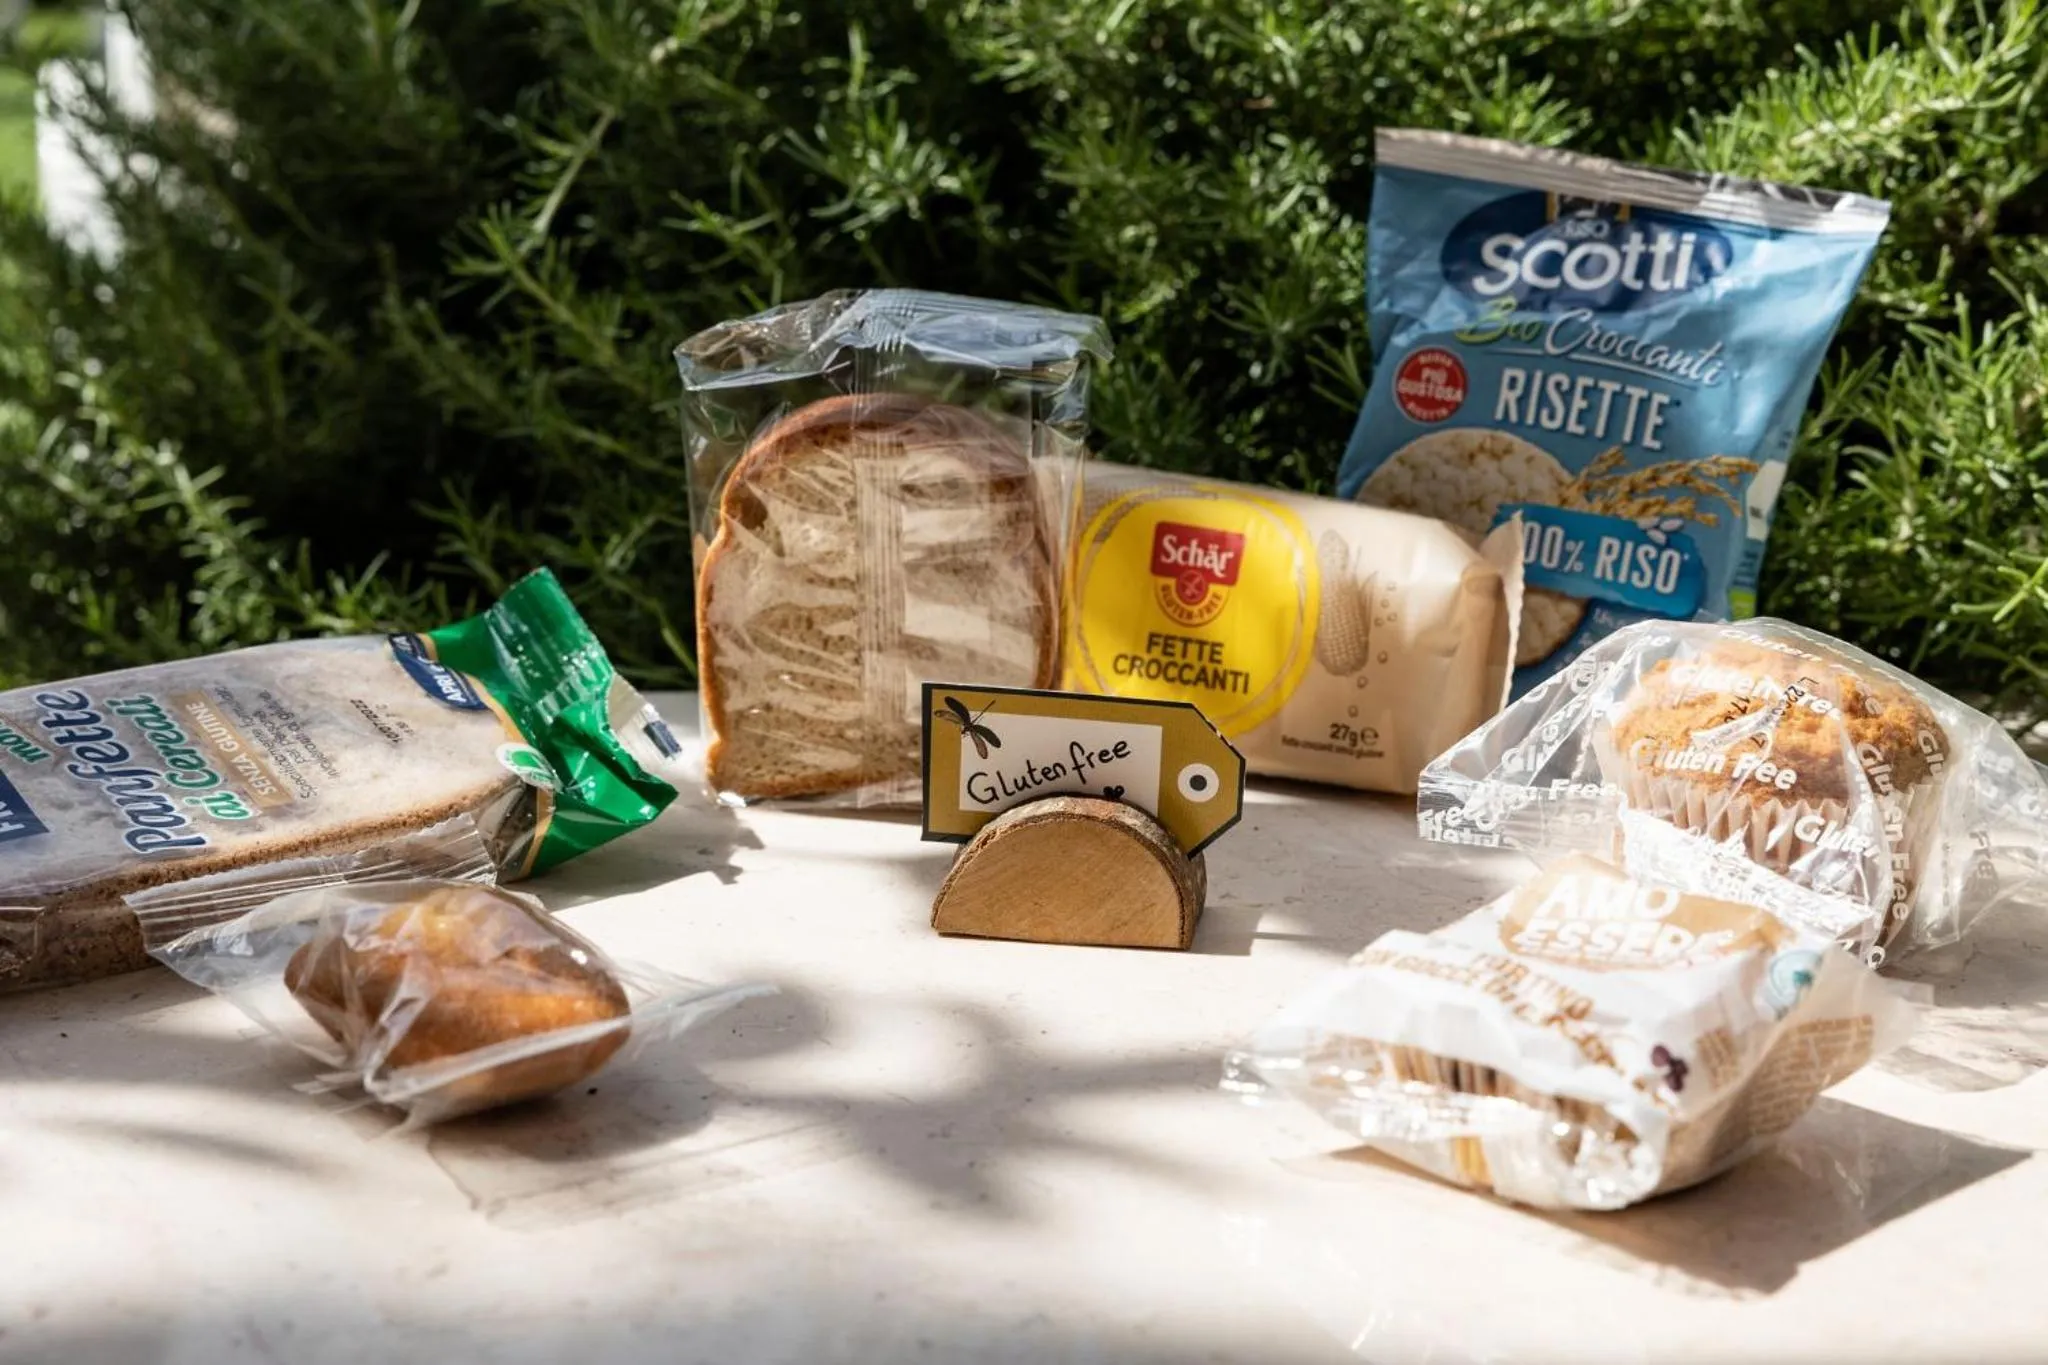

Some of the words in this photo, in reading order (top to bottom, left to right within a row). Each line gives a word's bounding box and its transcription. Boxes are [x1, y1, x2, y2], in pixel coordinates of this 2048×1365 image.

[1544, 310, 1726, 386] Croccanti
[1494, 368, 1670, 450] RISETTE
[1160, 534, 1235, 577] Schär
[1522, 521, 1584, 573] 00%
[1113, 654, 1250, 694] CROCCANTI
[1147, 632, 1224, 665] FETTE
[106, 694, 220, 789] Cereali
[186, 701, 239, 752] GLUTINE
[37, 689, 207, 853] Panfette
[232, 752, 277, 796] SENZA
[967, 760, 1067, 804] Gluten
[1069, 740, 1131, 785] free
[1631, 737, 1726, 775] Gluten
[185, 791, 251, 819] ai
